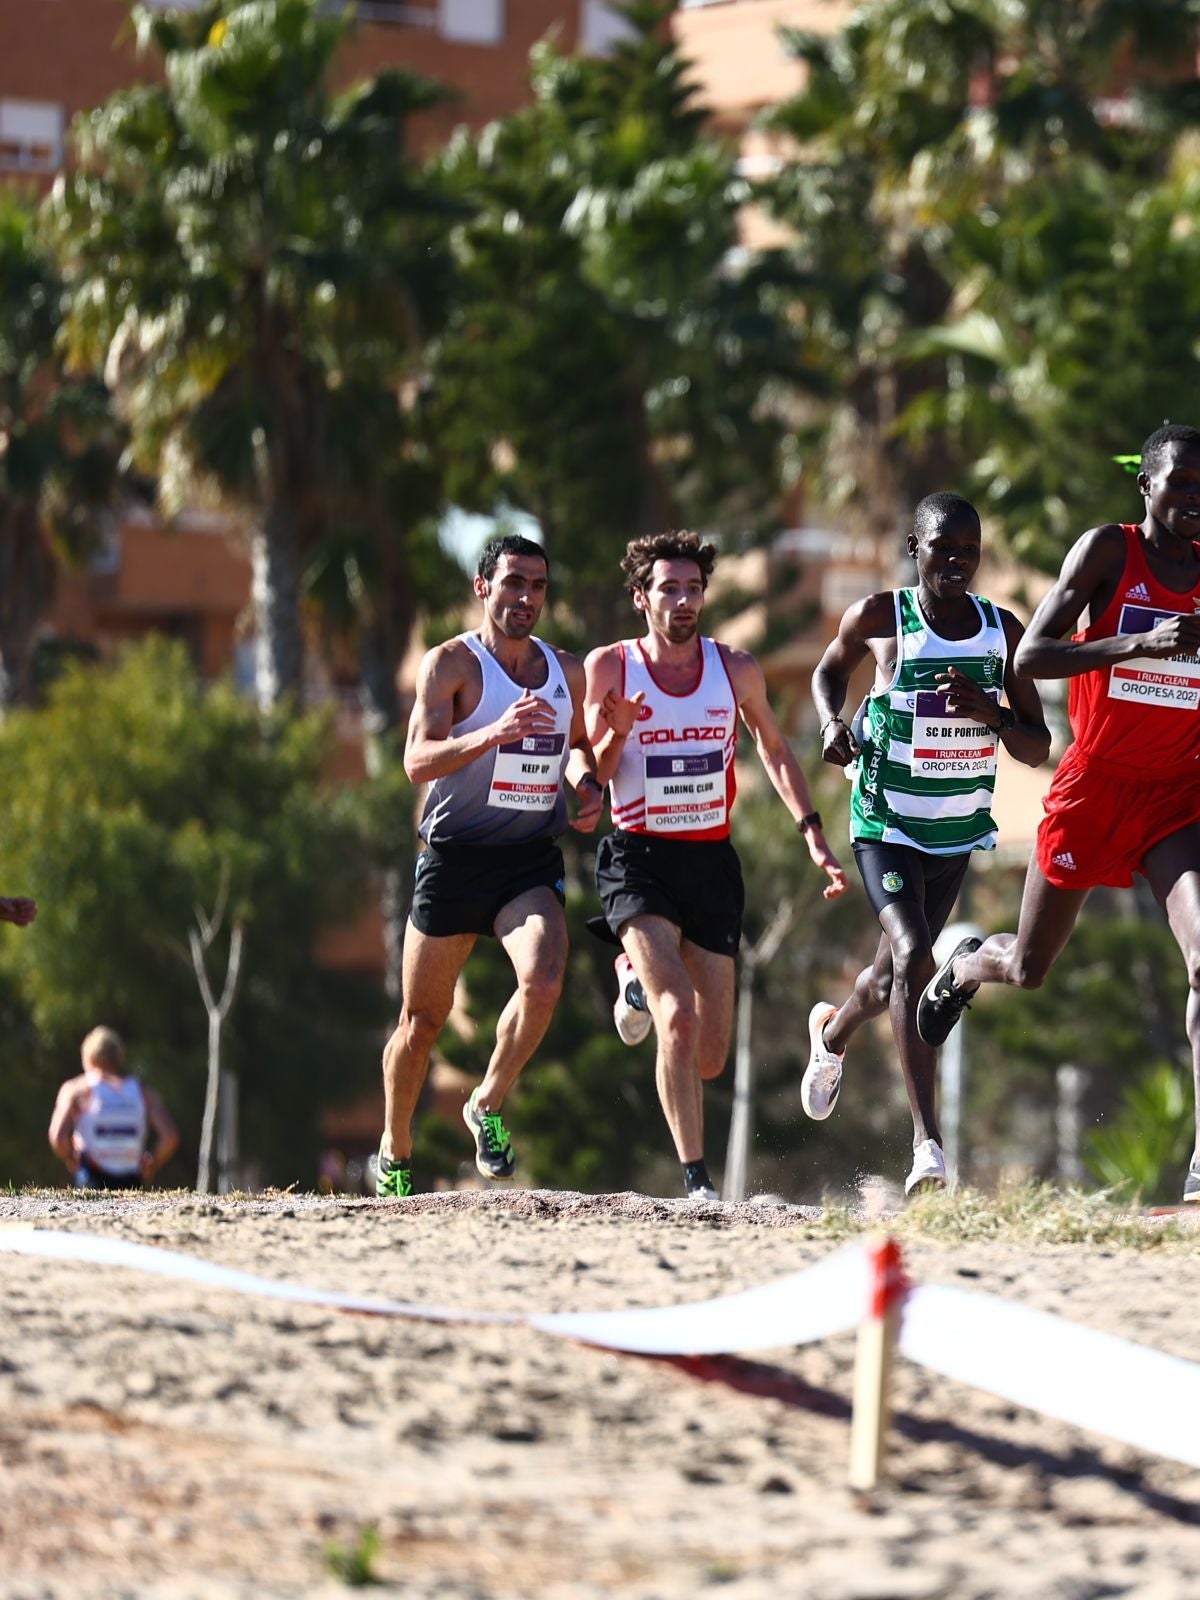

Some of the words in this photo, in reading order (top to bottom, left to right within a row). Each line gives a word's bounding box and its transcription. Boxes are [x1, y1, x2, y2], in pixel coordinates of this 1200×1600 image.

[1125, 592, 1151, 602] adidas
[1137, 672, 1141, 680] I
[1142, 673, 1162, 683] RUN
[1164, 676, 1189, 687] CLEAN
[1121, 682, 1175, 699] OROPESA
[639, 727, 726, 745] GOLAZO
[926, 727, 939, 738] SC
[941, 727, 953, 738] DE
[521, 763, 540, 774] KEEP
[540, 765, 550, 774] UP
[922, 761, 970, 771] OROPESA
[515, 784, 532, 792] RUN
[663, 785, 694, 795] DARING
[499, 793, 540, 804] OROPESA
[688, 803, 711, 812] CLEAN
[655, 814, 701, 826] OROPESA
